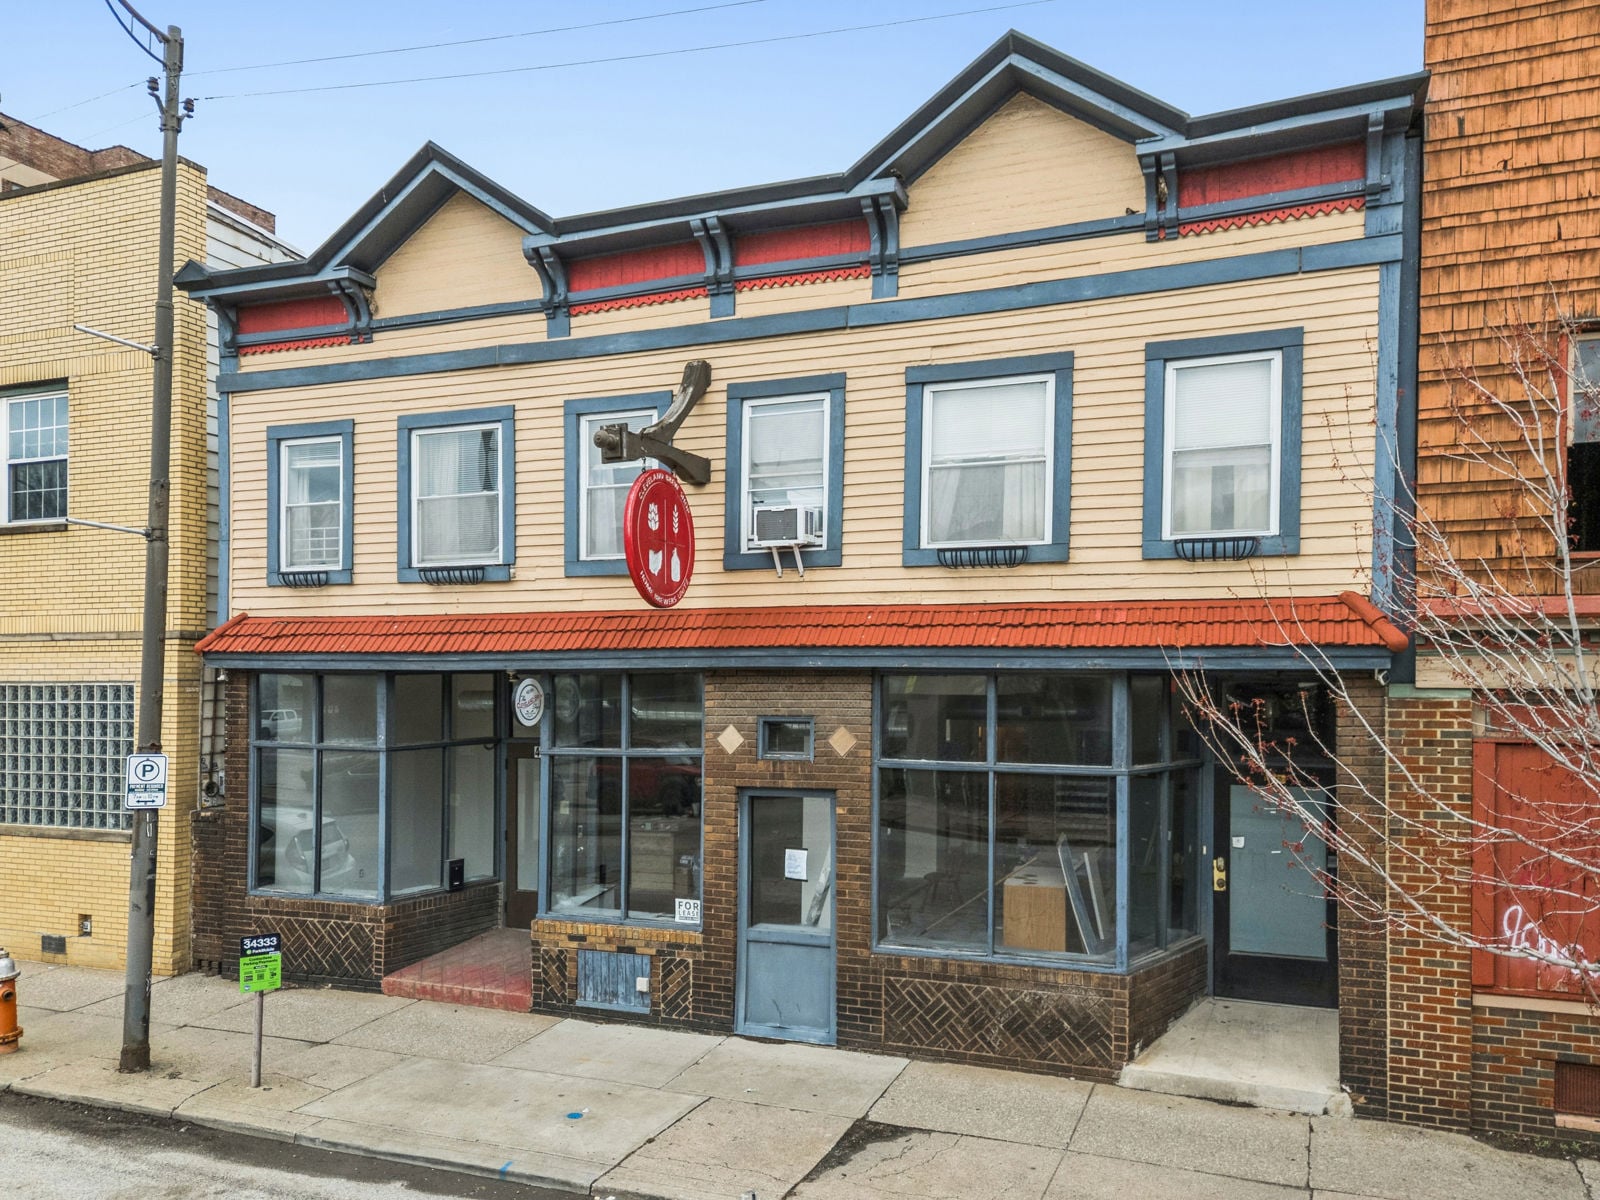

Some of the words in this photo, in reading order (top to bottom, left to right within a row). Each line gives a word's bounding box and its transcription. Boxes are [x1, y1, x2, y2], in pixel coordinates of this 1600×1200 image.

[638, 472, 664, 500] CLEVELAND
[142, 764, 154, 777] P
[678, 901, 699, 911] FOR
[243, 936, 278, 949] 34333
